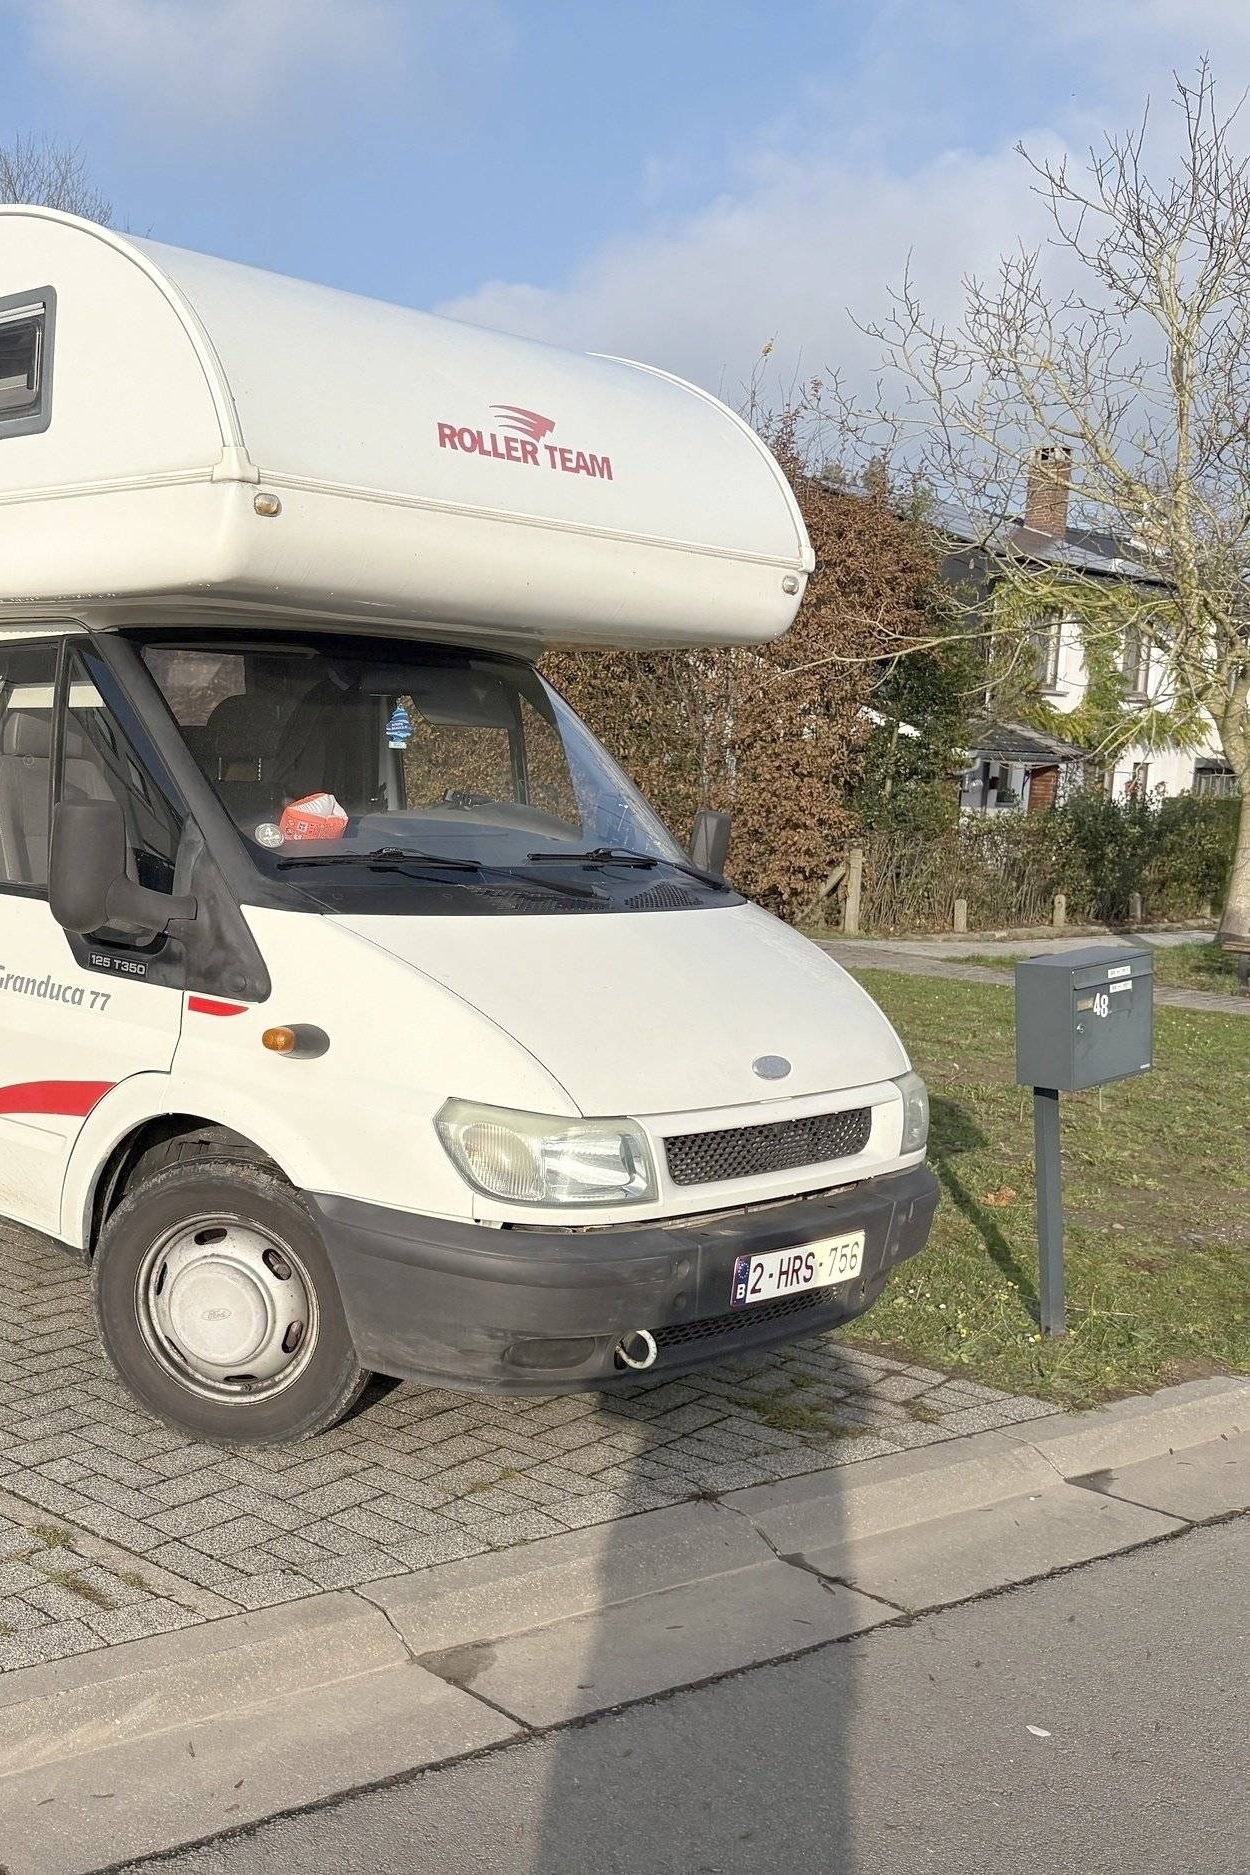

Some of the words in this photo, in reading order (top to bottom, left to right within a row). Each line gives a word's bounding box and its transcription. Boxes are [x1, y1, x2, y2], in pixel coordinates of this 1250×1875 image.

[437, 422, 540, 467] ROLLER
[544, 444, 613, 481] TEAM
[91, 954, 111, 968] 125
[113, 958, 146, 975] T350
[89, 990, 111, 1011] 77
[1093, 992, 1108, 1018] 48
[750, 1241, 860, 1295] 2-HRS-756
[736, 1283, 746, 1299] B
